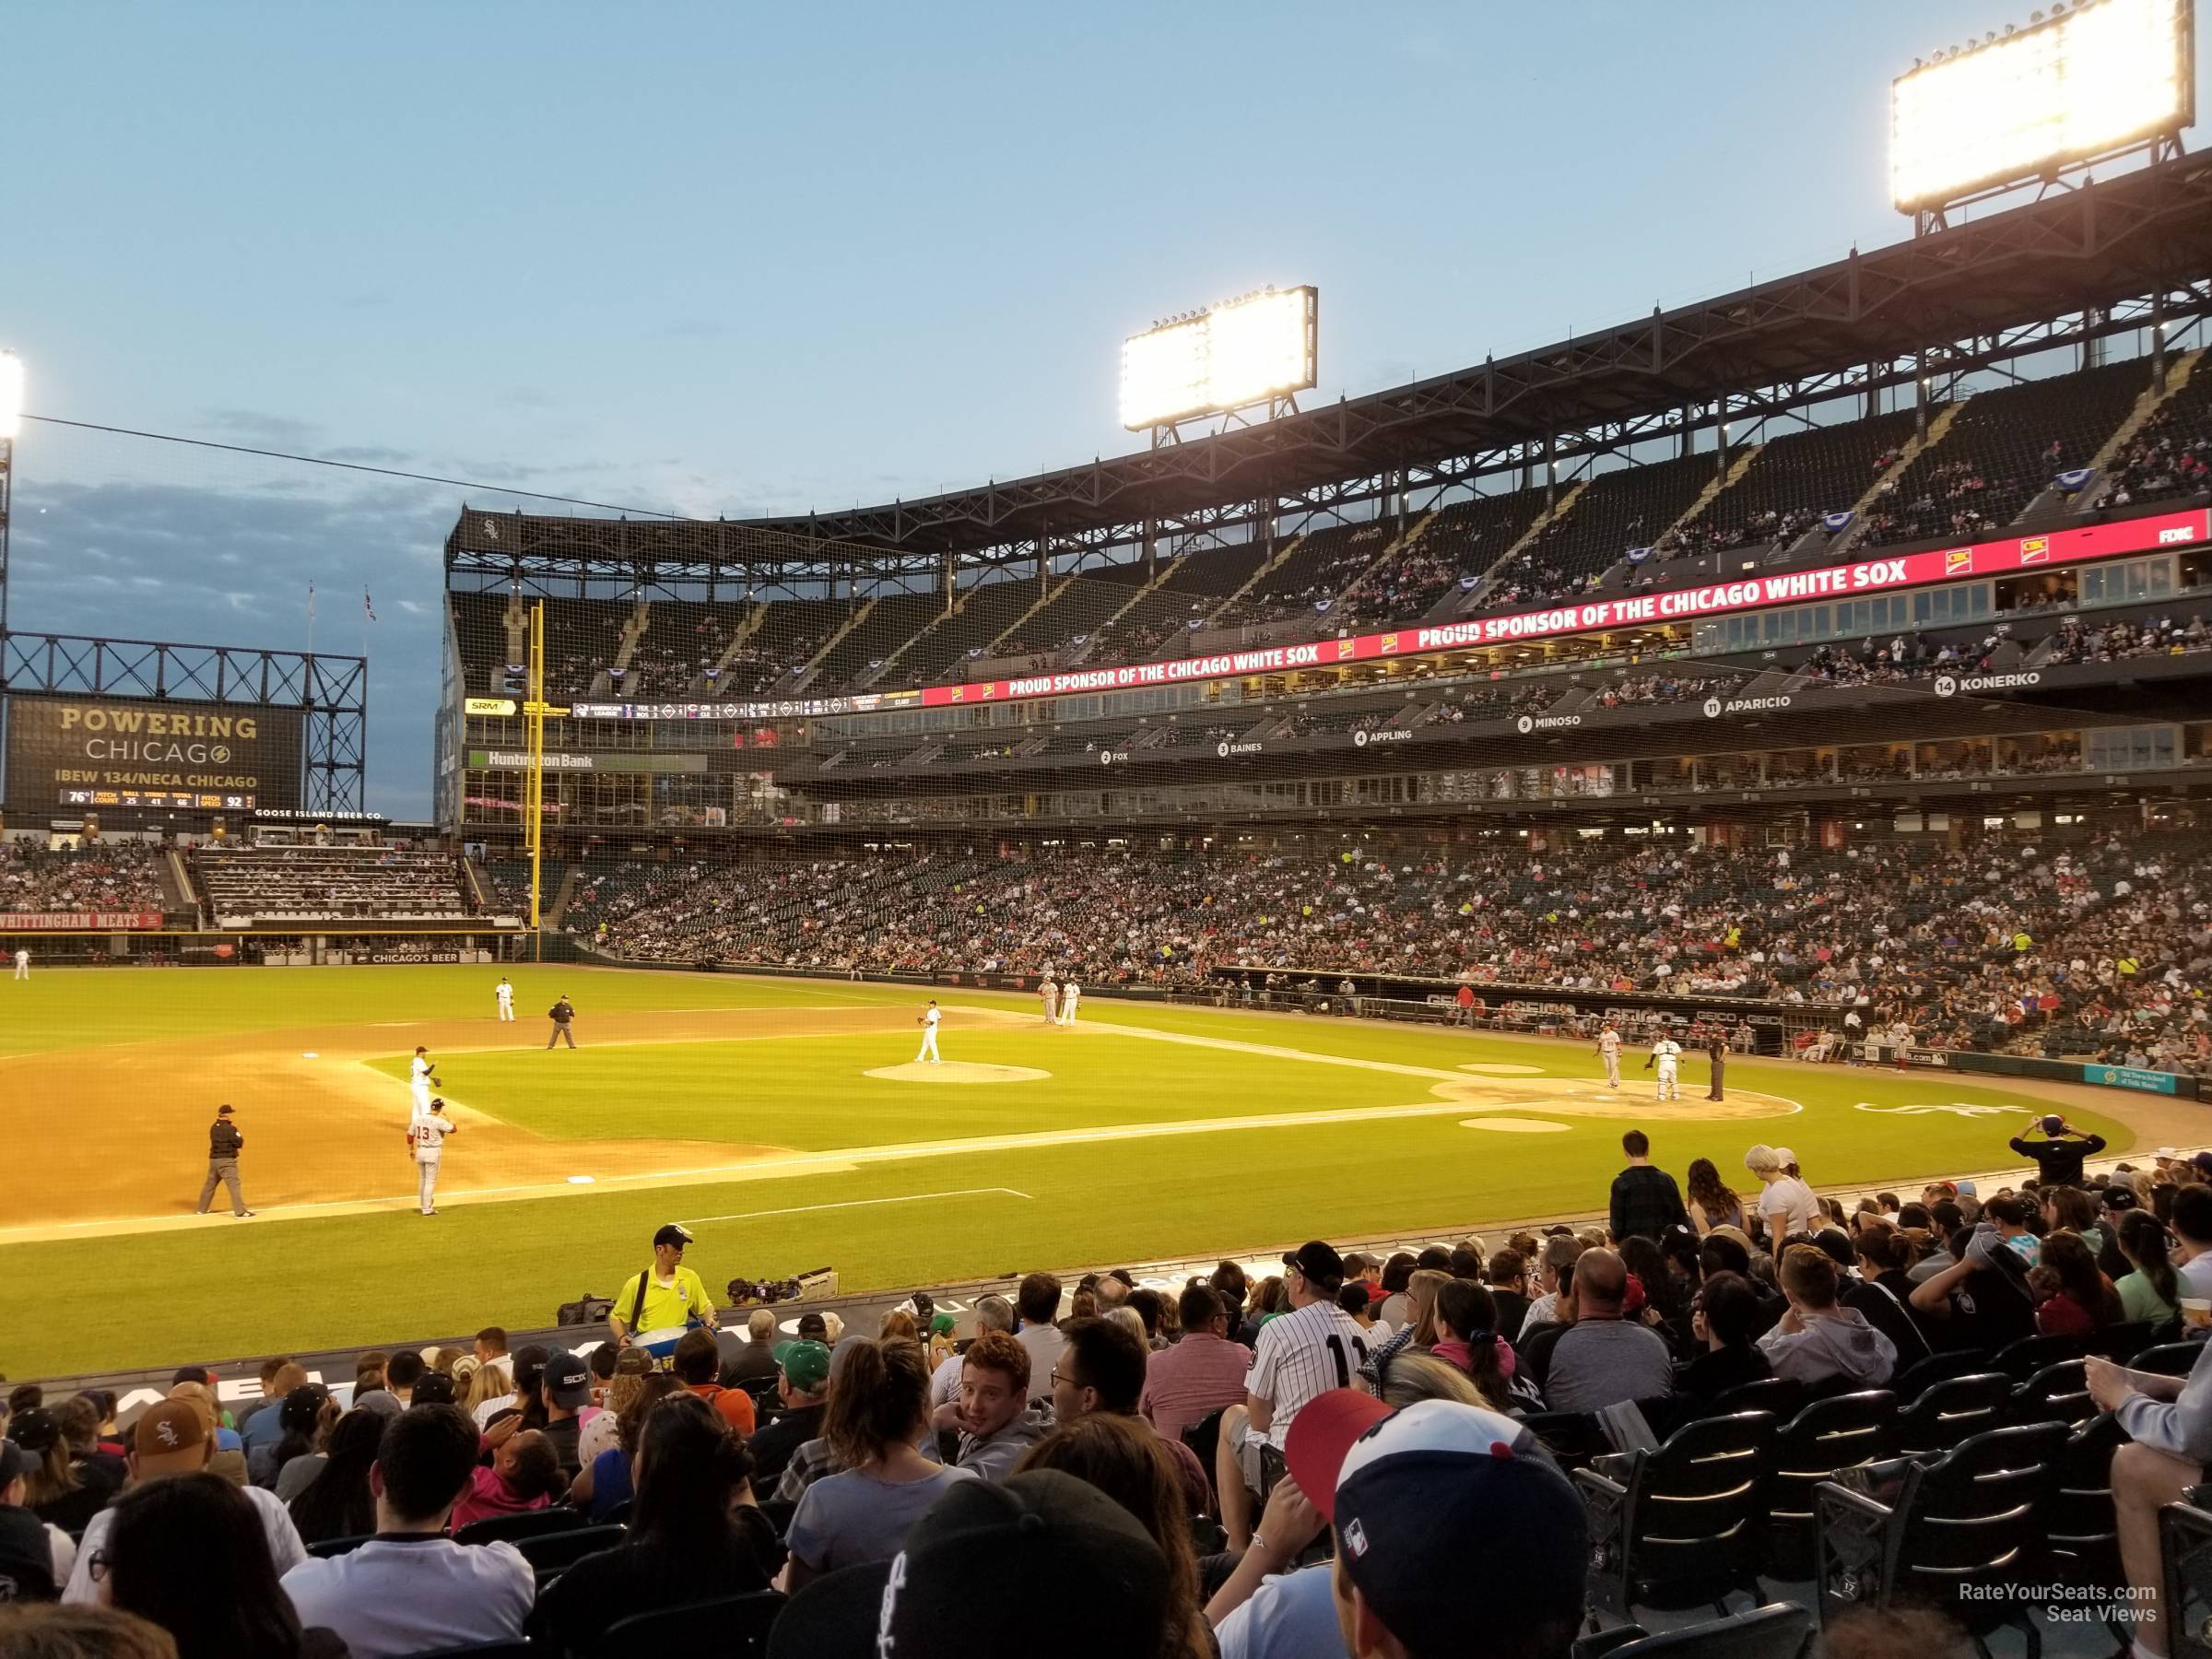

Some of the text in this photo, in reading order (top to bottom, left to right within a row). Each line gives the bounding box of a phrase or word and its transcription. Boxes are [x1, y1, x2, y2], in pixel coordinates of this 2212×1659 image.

[2159, 525, 2194, 544] FDIC
[1418, 559, 1908, 648] PROUD SPONSOR OF THE CHICAGO WHITE SOX
[1009, 645, 1318, 696] PROUD SPONSOR OF THE CHICAGO WHITE SOX
[1937, 672, 2041, 693] 14 KONERKO
[1707, 696, 1791, 713] 11 APARICIO
[60, 708, 257, 738] POWERING
[1535, 715, 1581, 728] MINOSO
[1370, 729, 1412, 742] APPLING
[86, 738, 230, 764] CHICAGO
[1231, 743, 1263, 753] BAINES
[560, 753, 593, 768] Bank
[1112, 752, 1128, 761] FOX
[55, 769, 257, 788] IBEW 134/NECA CHICAGO
[228, 796, 241, 807] 92
[254, 808, 291, 818] GOOSE
[295, 810, 334, 818] ISLAND
[96, 914, 139, 928] MEATS
[372, 951, 457, 963] CHICAGO'S BEER
[1427, 994, 1486, 1012] GEIO
[1697, 1010, 1736, 1022] GEICO
[417, 1125, 429, 1140] 13
[563, 1372, 587, 1384] SOX
